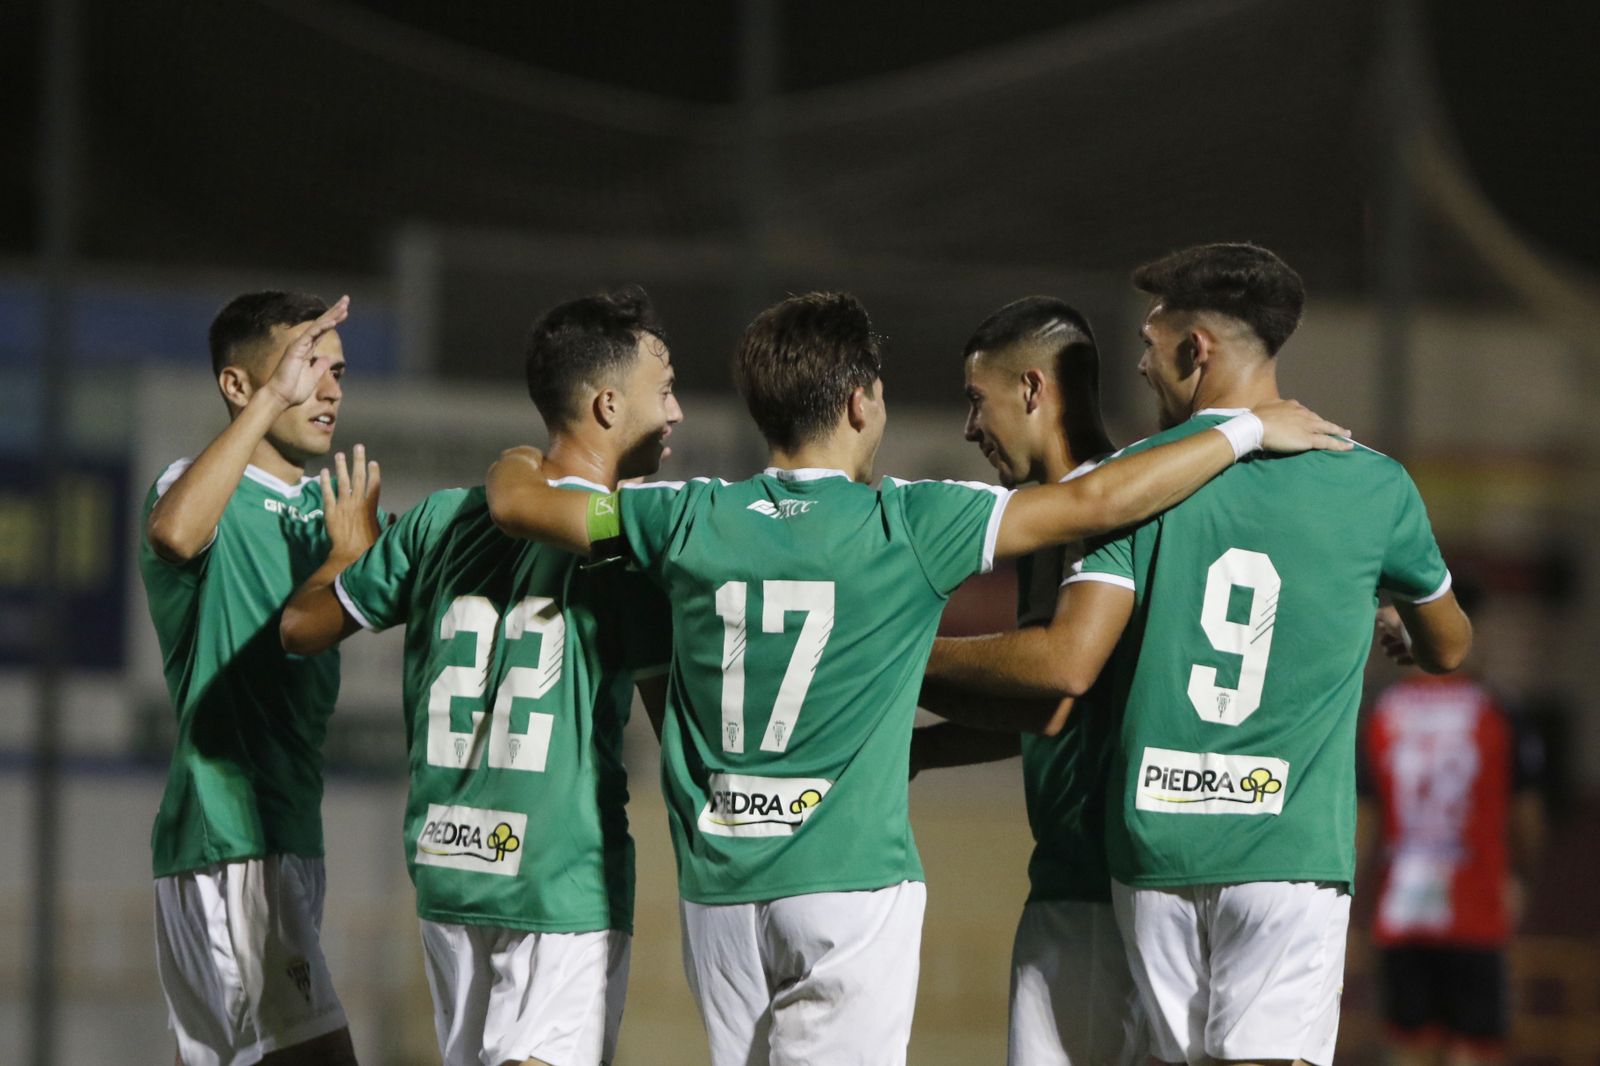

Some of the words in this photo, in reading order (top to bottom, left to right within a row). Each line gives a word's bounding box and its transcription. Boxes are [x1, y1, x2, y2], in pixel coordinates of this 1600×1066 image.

[426, 595, 566, 773] 22
[715, 579, 836, 754] 17
[1187, 547, 1281, 726] 9
